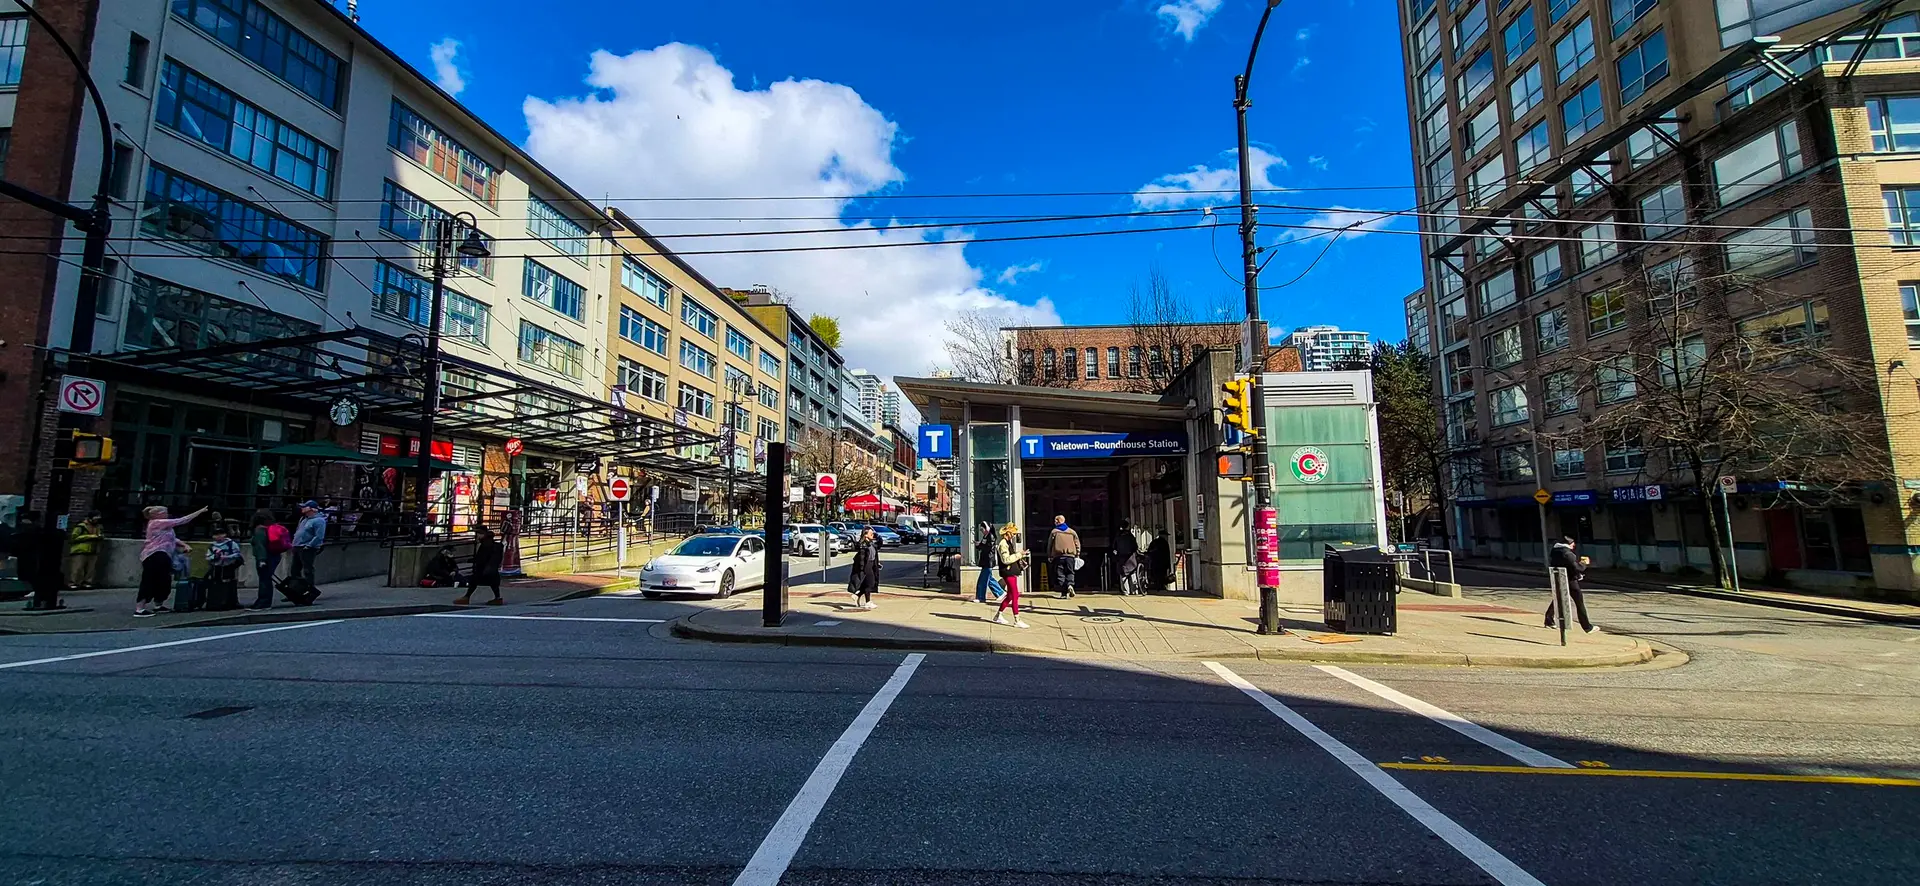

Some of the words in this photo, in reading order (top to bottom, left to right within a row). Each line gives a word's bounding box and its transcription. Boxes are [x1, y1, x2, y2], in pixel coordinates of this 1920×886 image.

[925, 430, 944, 453] T
[1025, 439, 1039, 455] T
[1050, 440, 1147, 451] Yaletown–Roundhouse
[1148, 439, 1179, 448] Station
[1300, 474, 1321, 482] PIZZA
